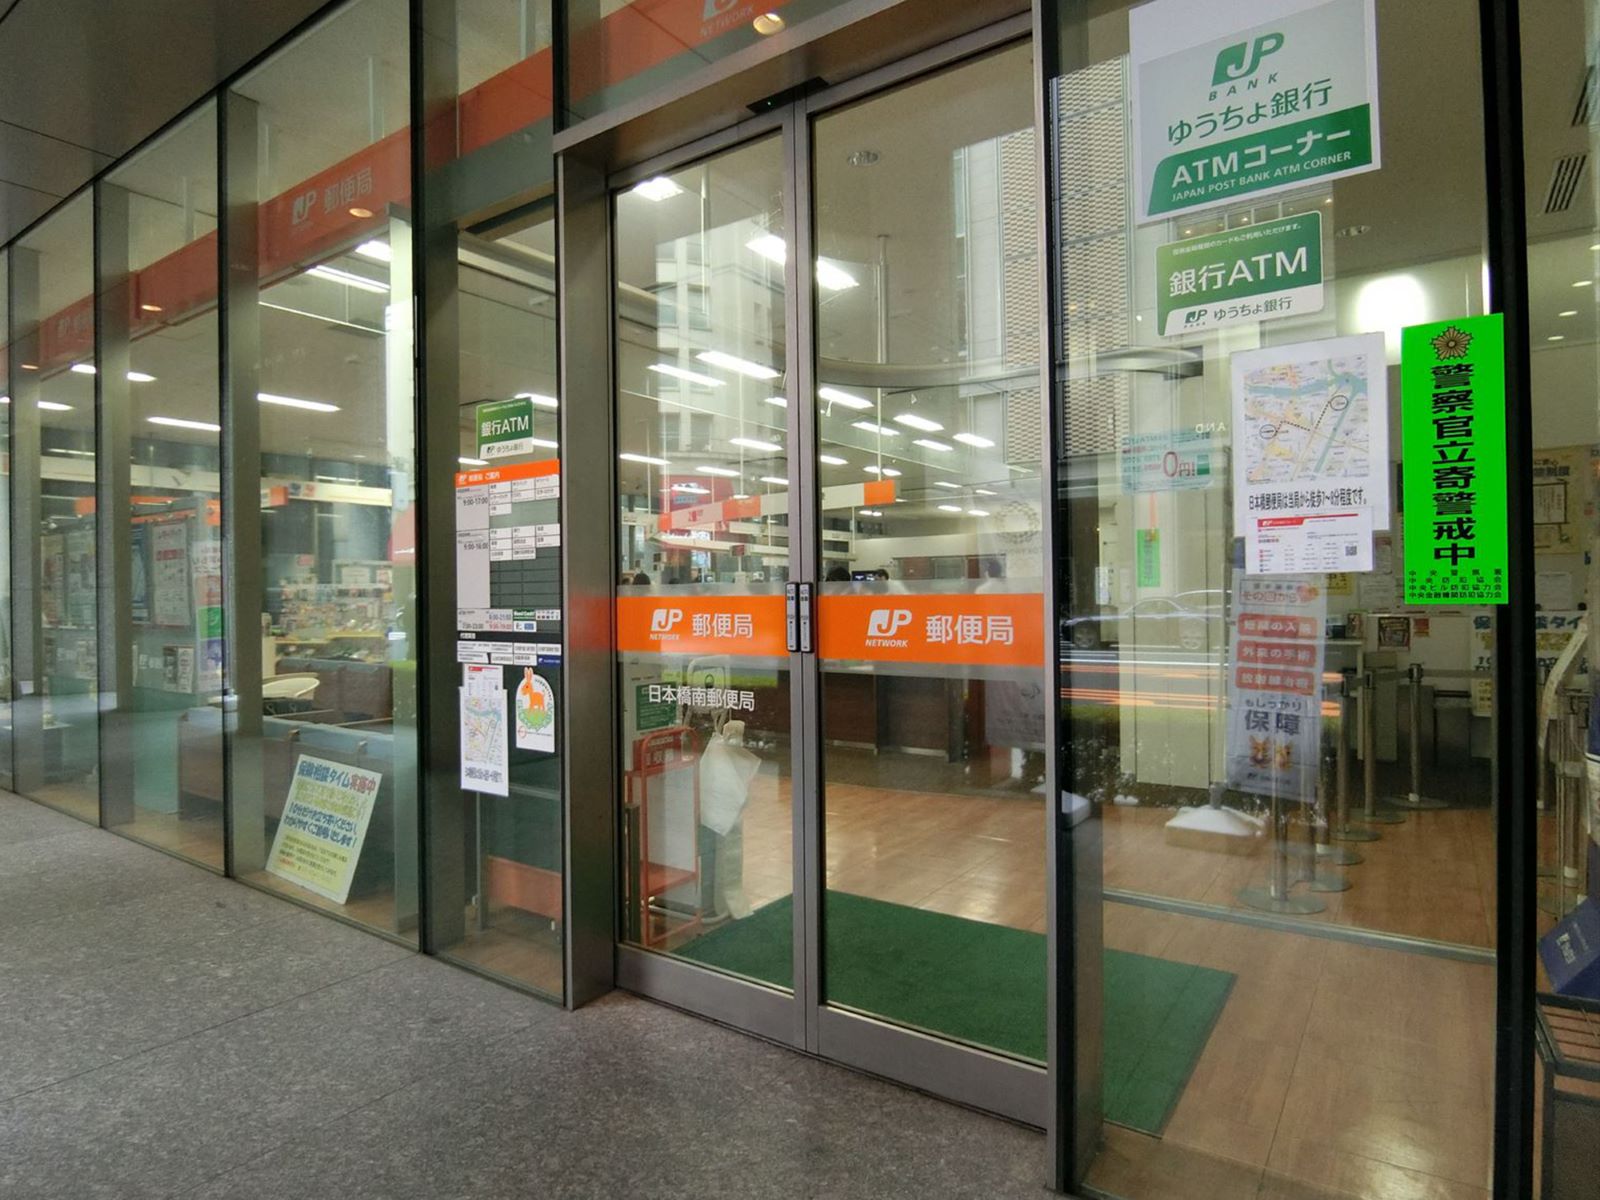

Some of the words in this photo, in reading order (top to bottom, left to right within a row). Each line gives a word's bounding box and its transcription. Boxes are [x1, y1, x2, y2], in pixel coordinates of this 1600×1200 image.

[1212, 32, 1285, 86] JP
[1209, 72, 1278, 101] BANK
[1168, 78, 1333, 146] ゆうちょ銀行
[1171, 130, 1351, 188] ATMコーナー
[1172, 187, 1205, 202] JAPAN
[1208, 179, 1236, 195] POST
[1239, 170, 1270, 186] BANK
[1273, 164, 1301, 178] ATM
[1303, 151, 1352, 170] CORNER
[1169, 246, 1308, 297] 銀行ATM
[1214, 296, 1293, 321] ゆうちょ銀行
[481, 415, 529, 437] 銀行ATM
[1430, 363, 1476, 567] 警察官立寄警戒中
[651, 609, 683, 632] JP
[691, 613, 753, 638] 郵便局
[867, 609, 912, 637] JP
[926, 615, 1014, 645] 郵便局
[865, 639, 909, 648] NETWORK
[649, 684, 755, 711] 日本橋南郵便局
[1244, 709, 1300, 736] 保障
